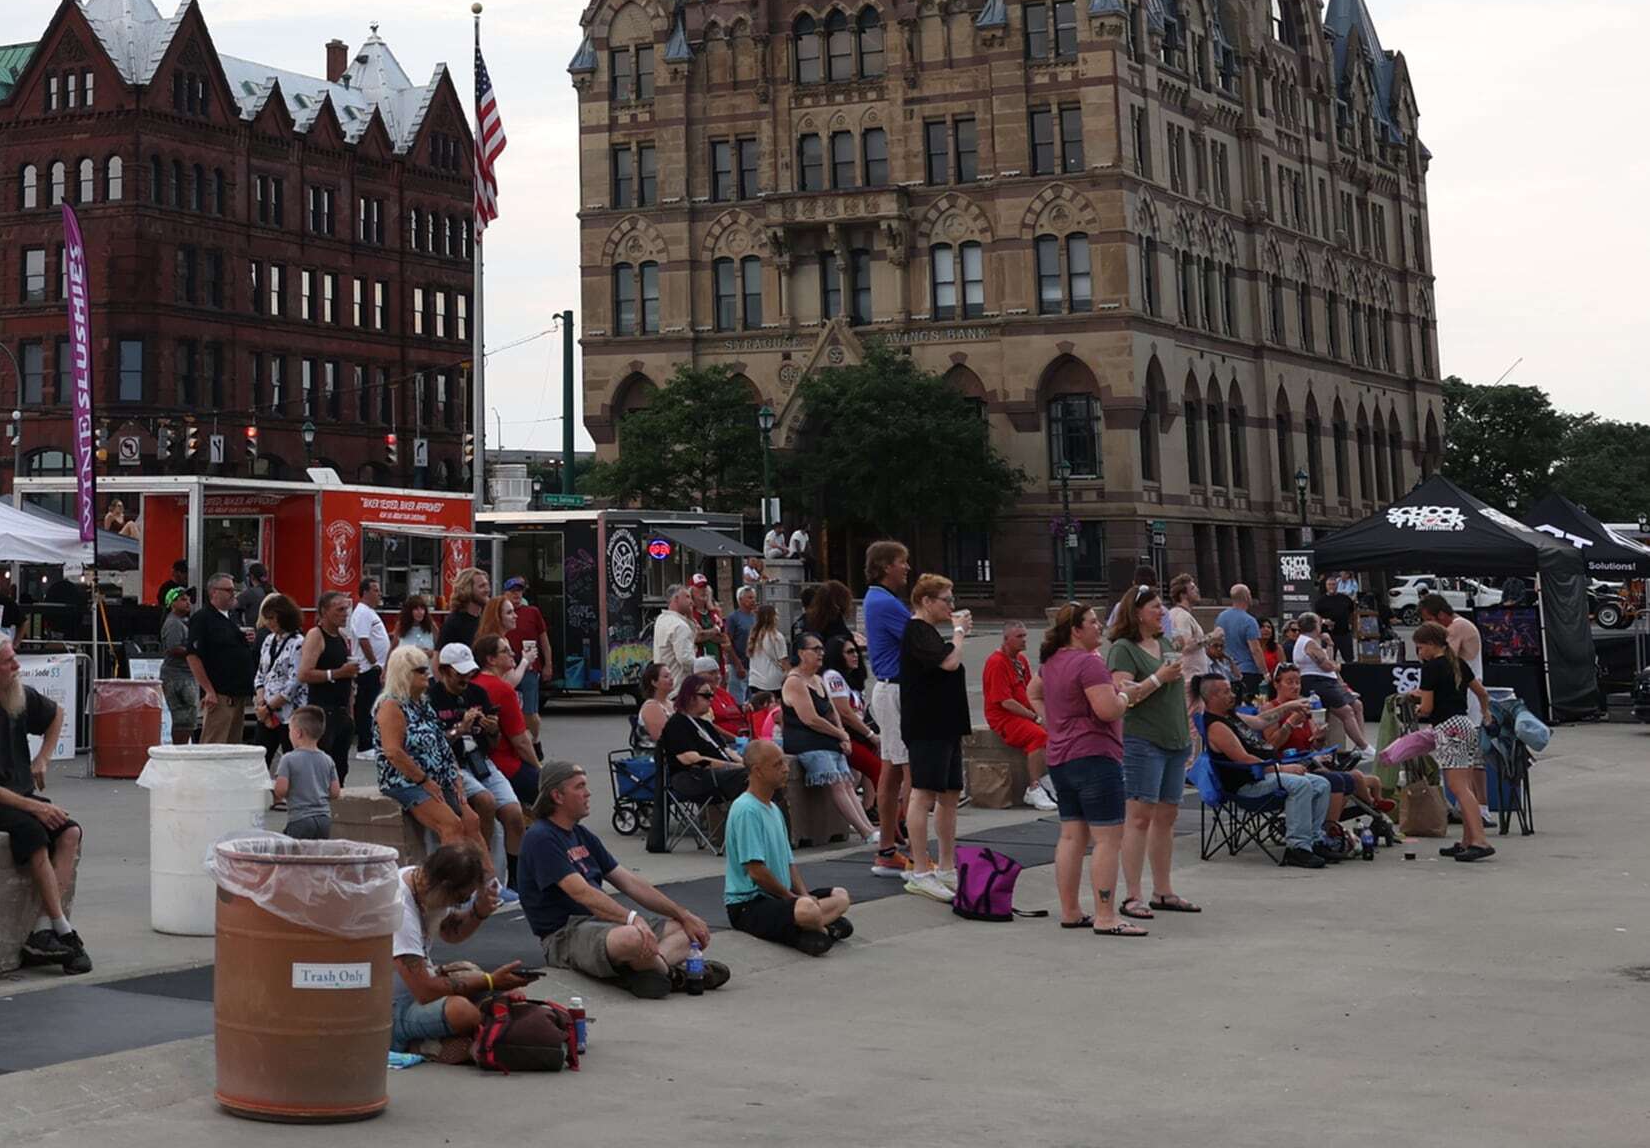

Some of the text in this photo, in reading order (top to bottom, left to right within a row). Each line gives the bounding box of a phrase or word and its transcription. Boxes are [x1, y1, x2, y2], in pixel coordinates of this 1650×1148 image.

[77, 414, 92, 532] WINE
[1387, 506, 1461, 517] SCHOOL
[649, 544, 671, 554] OPEN
[1280, 556, 1307, 566] SCHOOL
[1588, 561, 1637, 571] Solutions!
[35, 666, 50, 677] Soda
[51, 667, 61, 678] $3
[301, 970, 365, 984] Trash Only
